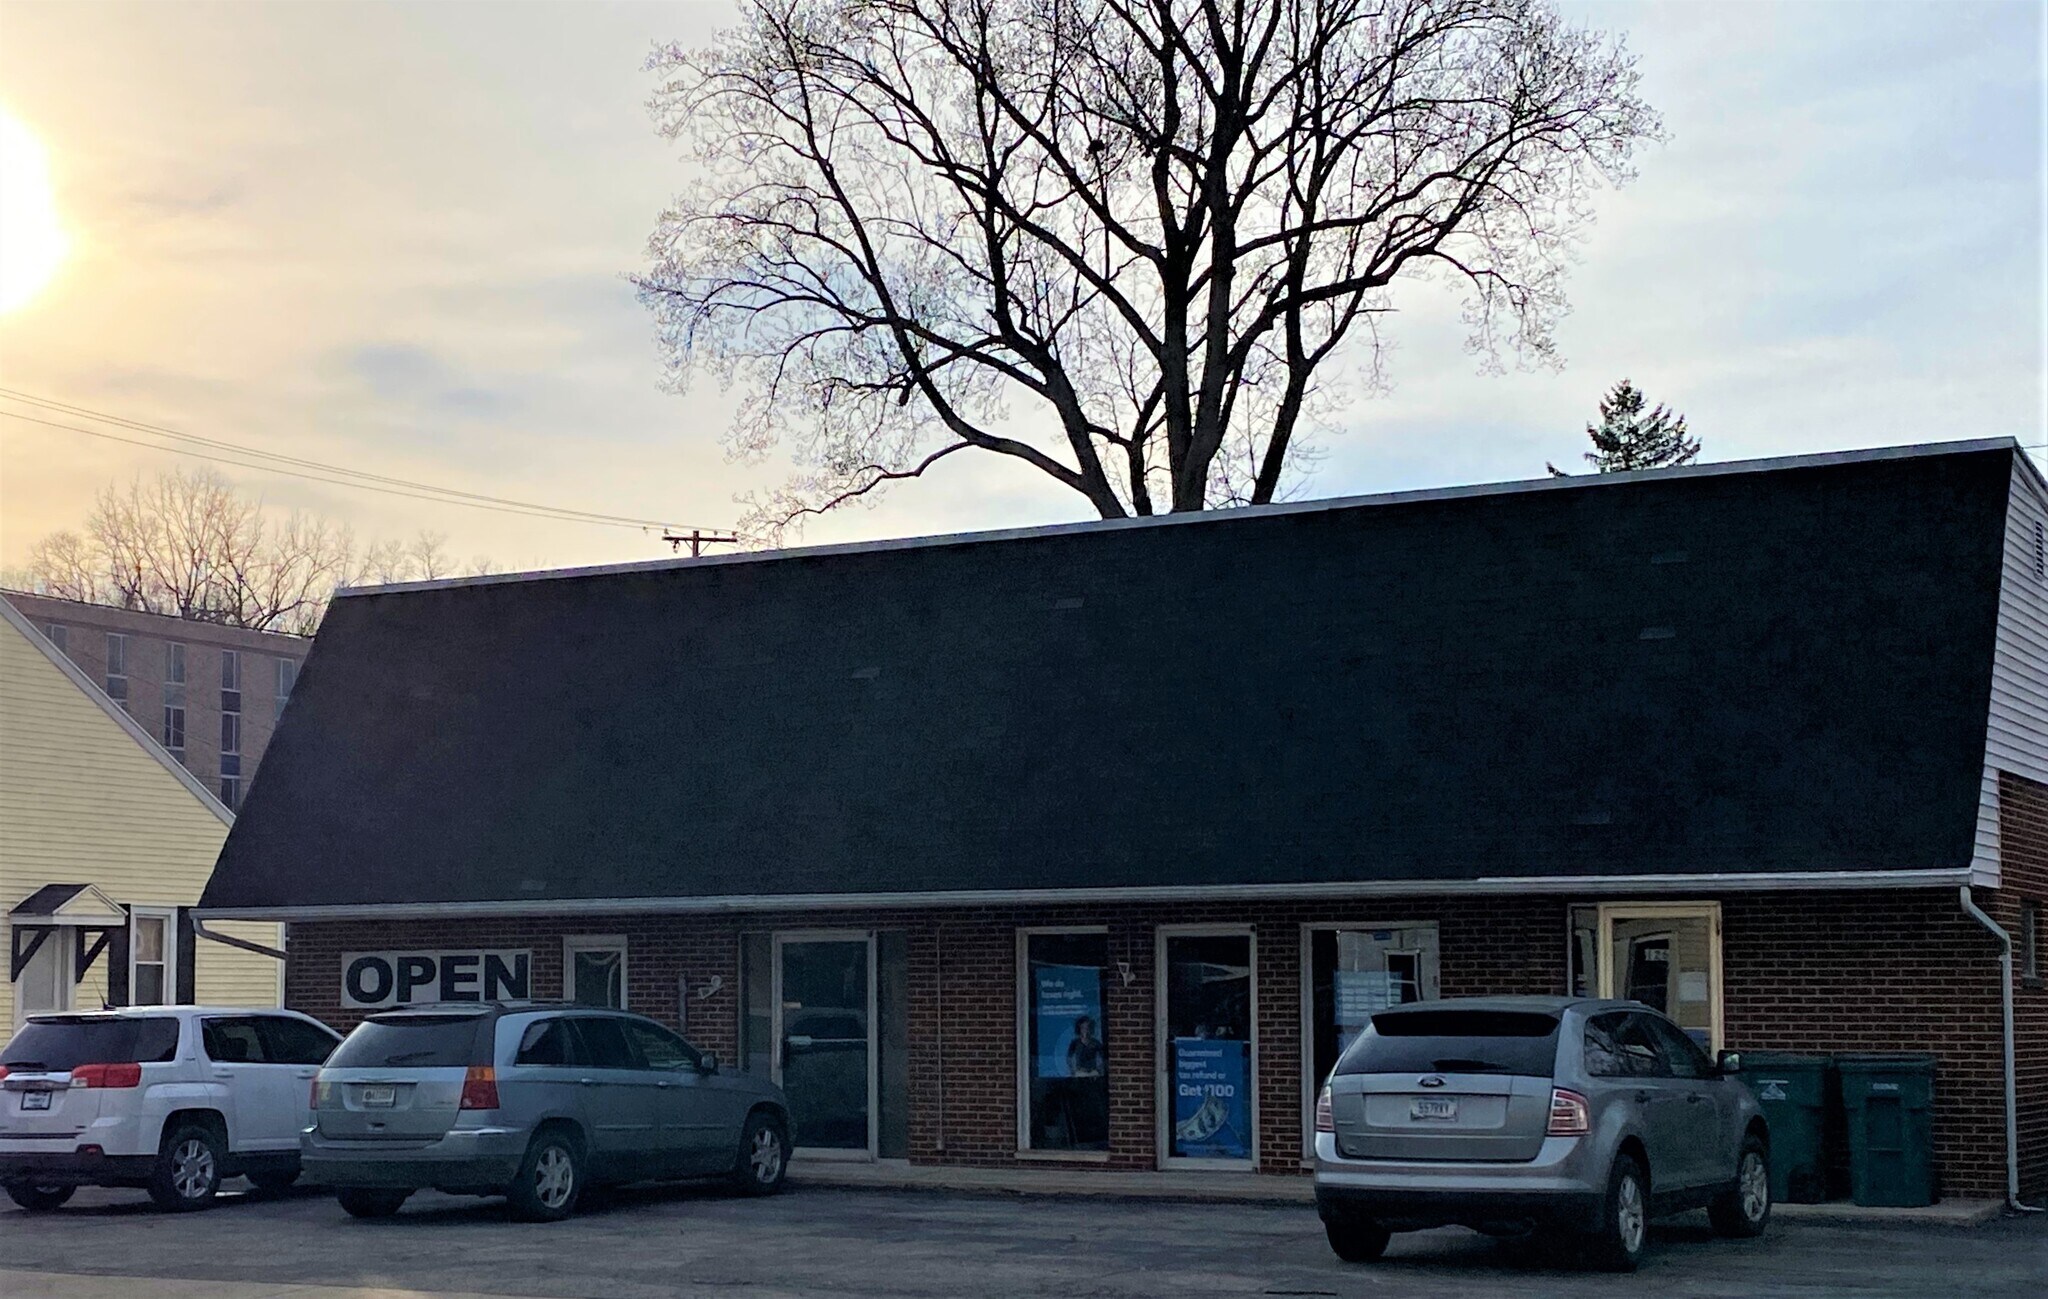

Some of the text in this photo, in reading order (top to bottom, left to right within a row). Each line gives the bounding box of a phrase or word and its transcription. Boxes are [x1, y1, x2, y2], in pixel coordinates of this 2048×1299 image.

[346, 954, 528, 1004] OPEN
[1178, 1048, 1223, 1057] Guaranteed
[1178, 1060, 1207, 1070] biggest
[1192, 1071, 1217, 1079] refund
[1179, 1084, 1202, 1096] Get
